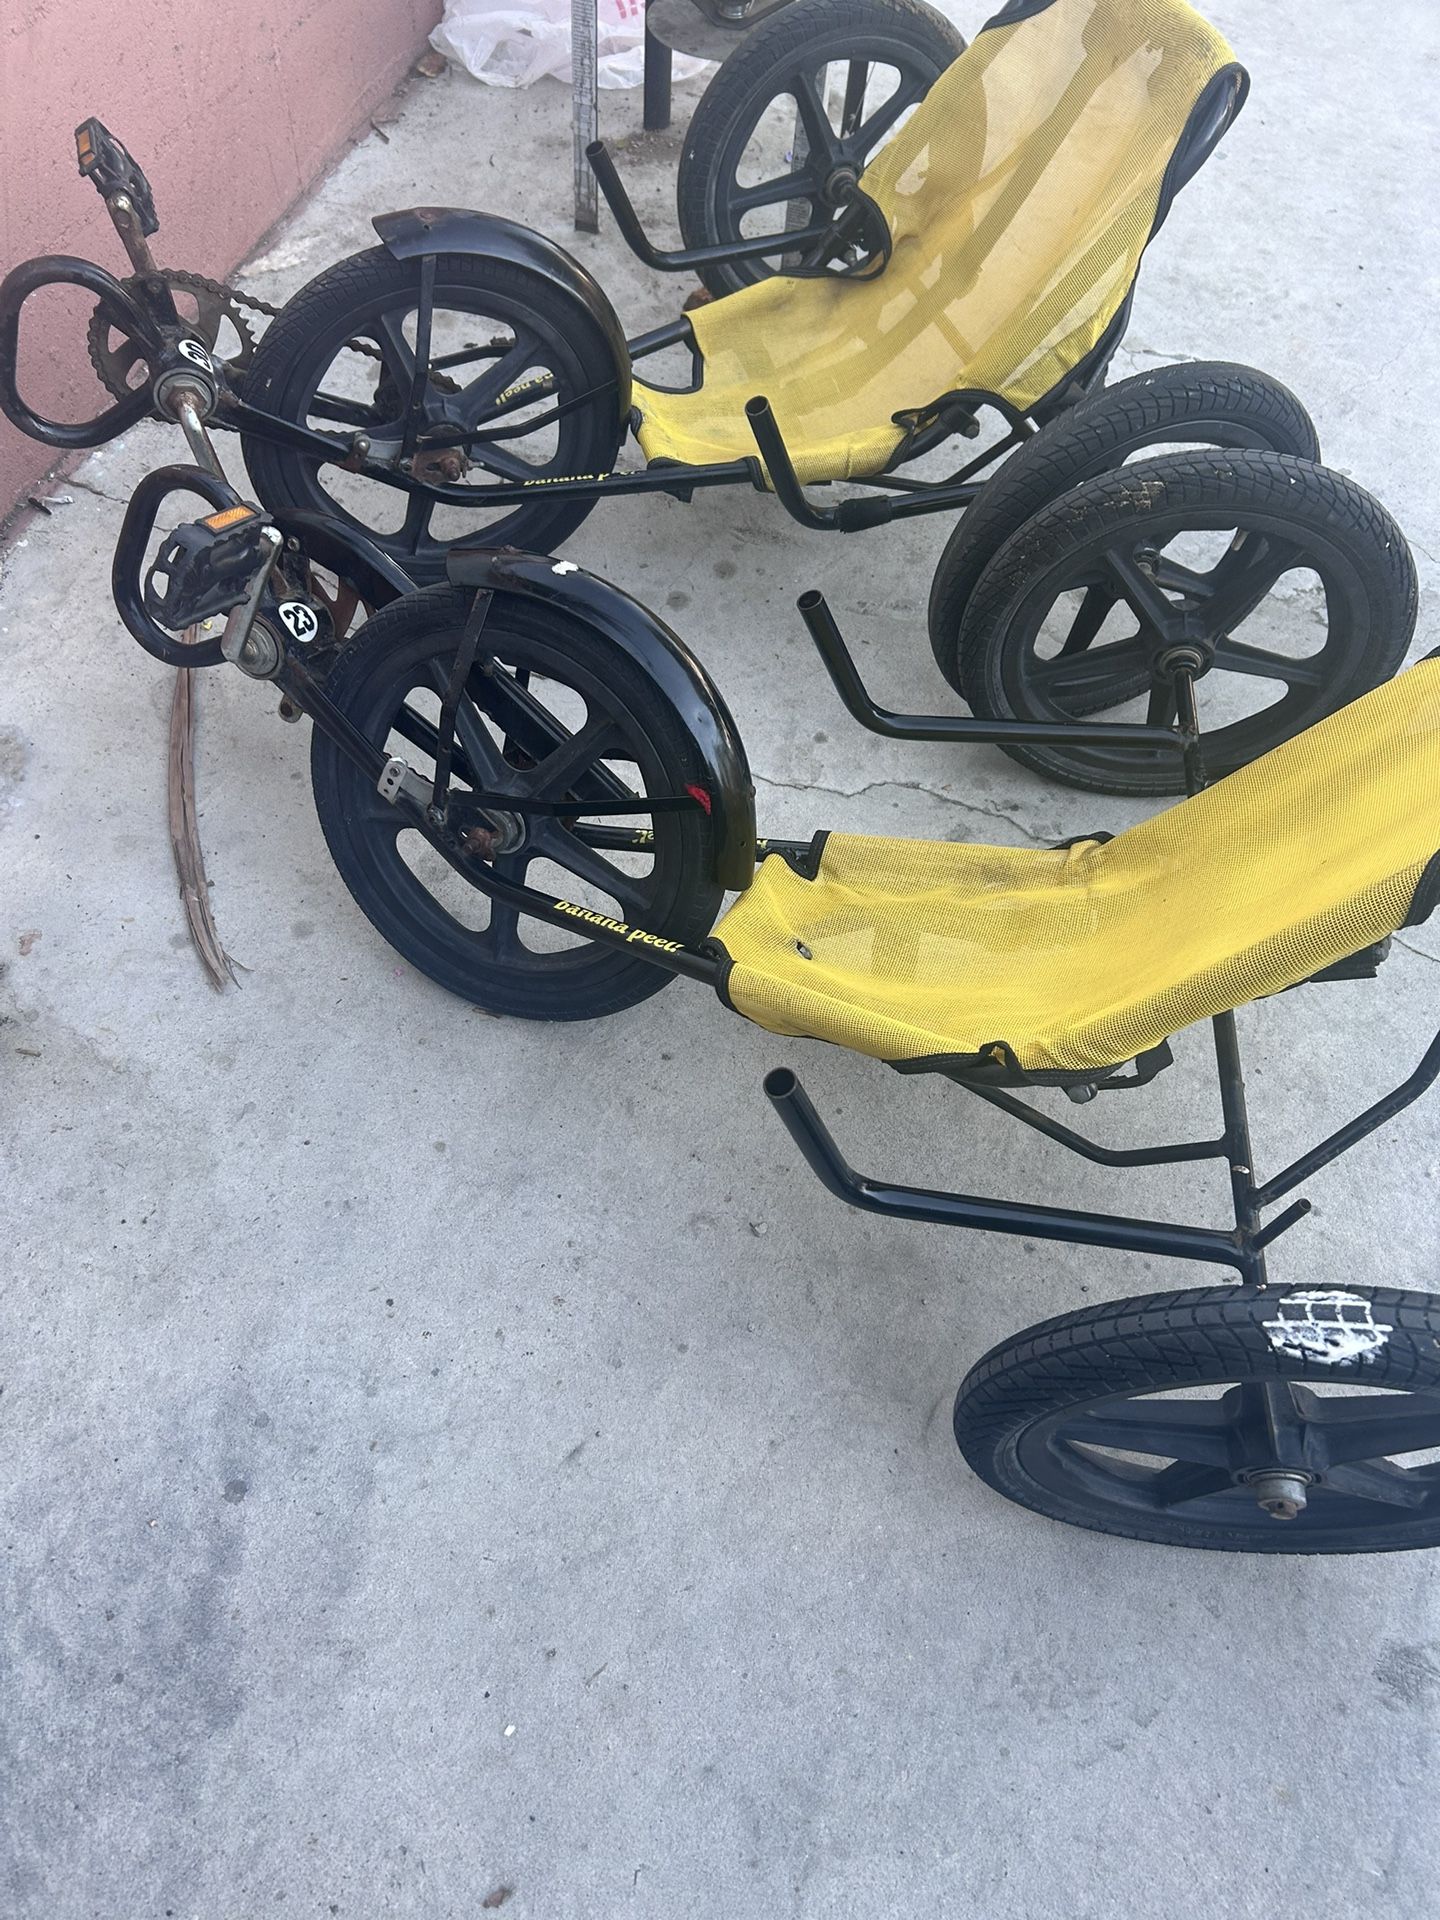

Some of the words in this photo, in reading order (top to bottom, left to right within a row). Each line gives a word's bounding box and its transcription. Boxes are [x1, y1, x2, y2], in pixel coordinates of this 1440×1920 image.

[184, 341, 212, 370] 30
[282, 604, 315, 637] 23
[552, 900, 630, 934] banana
